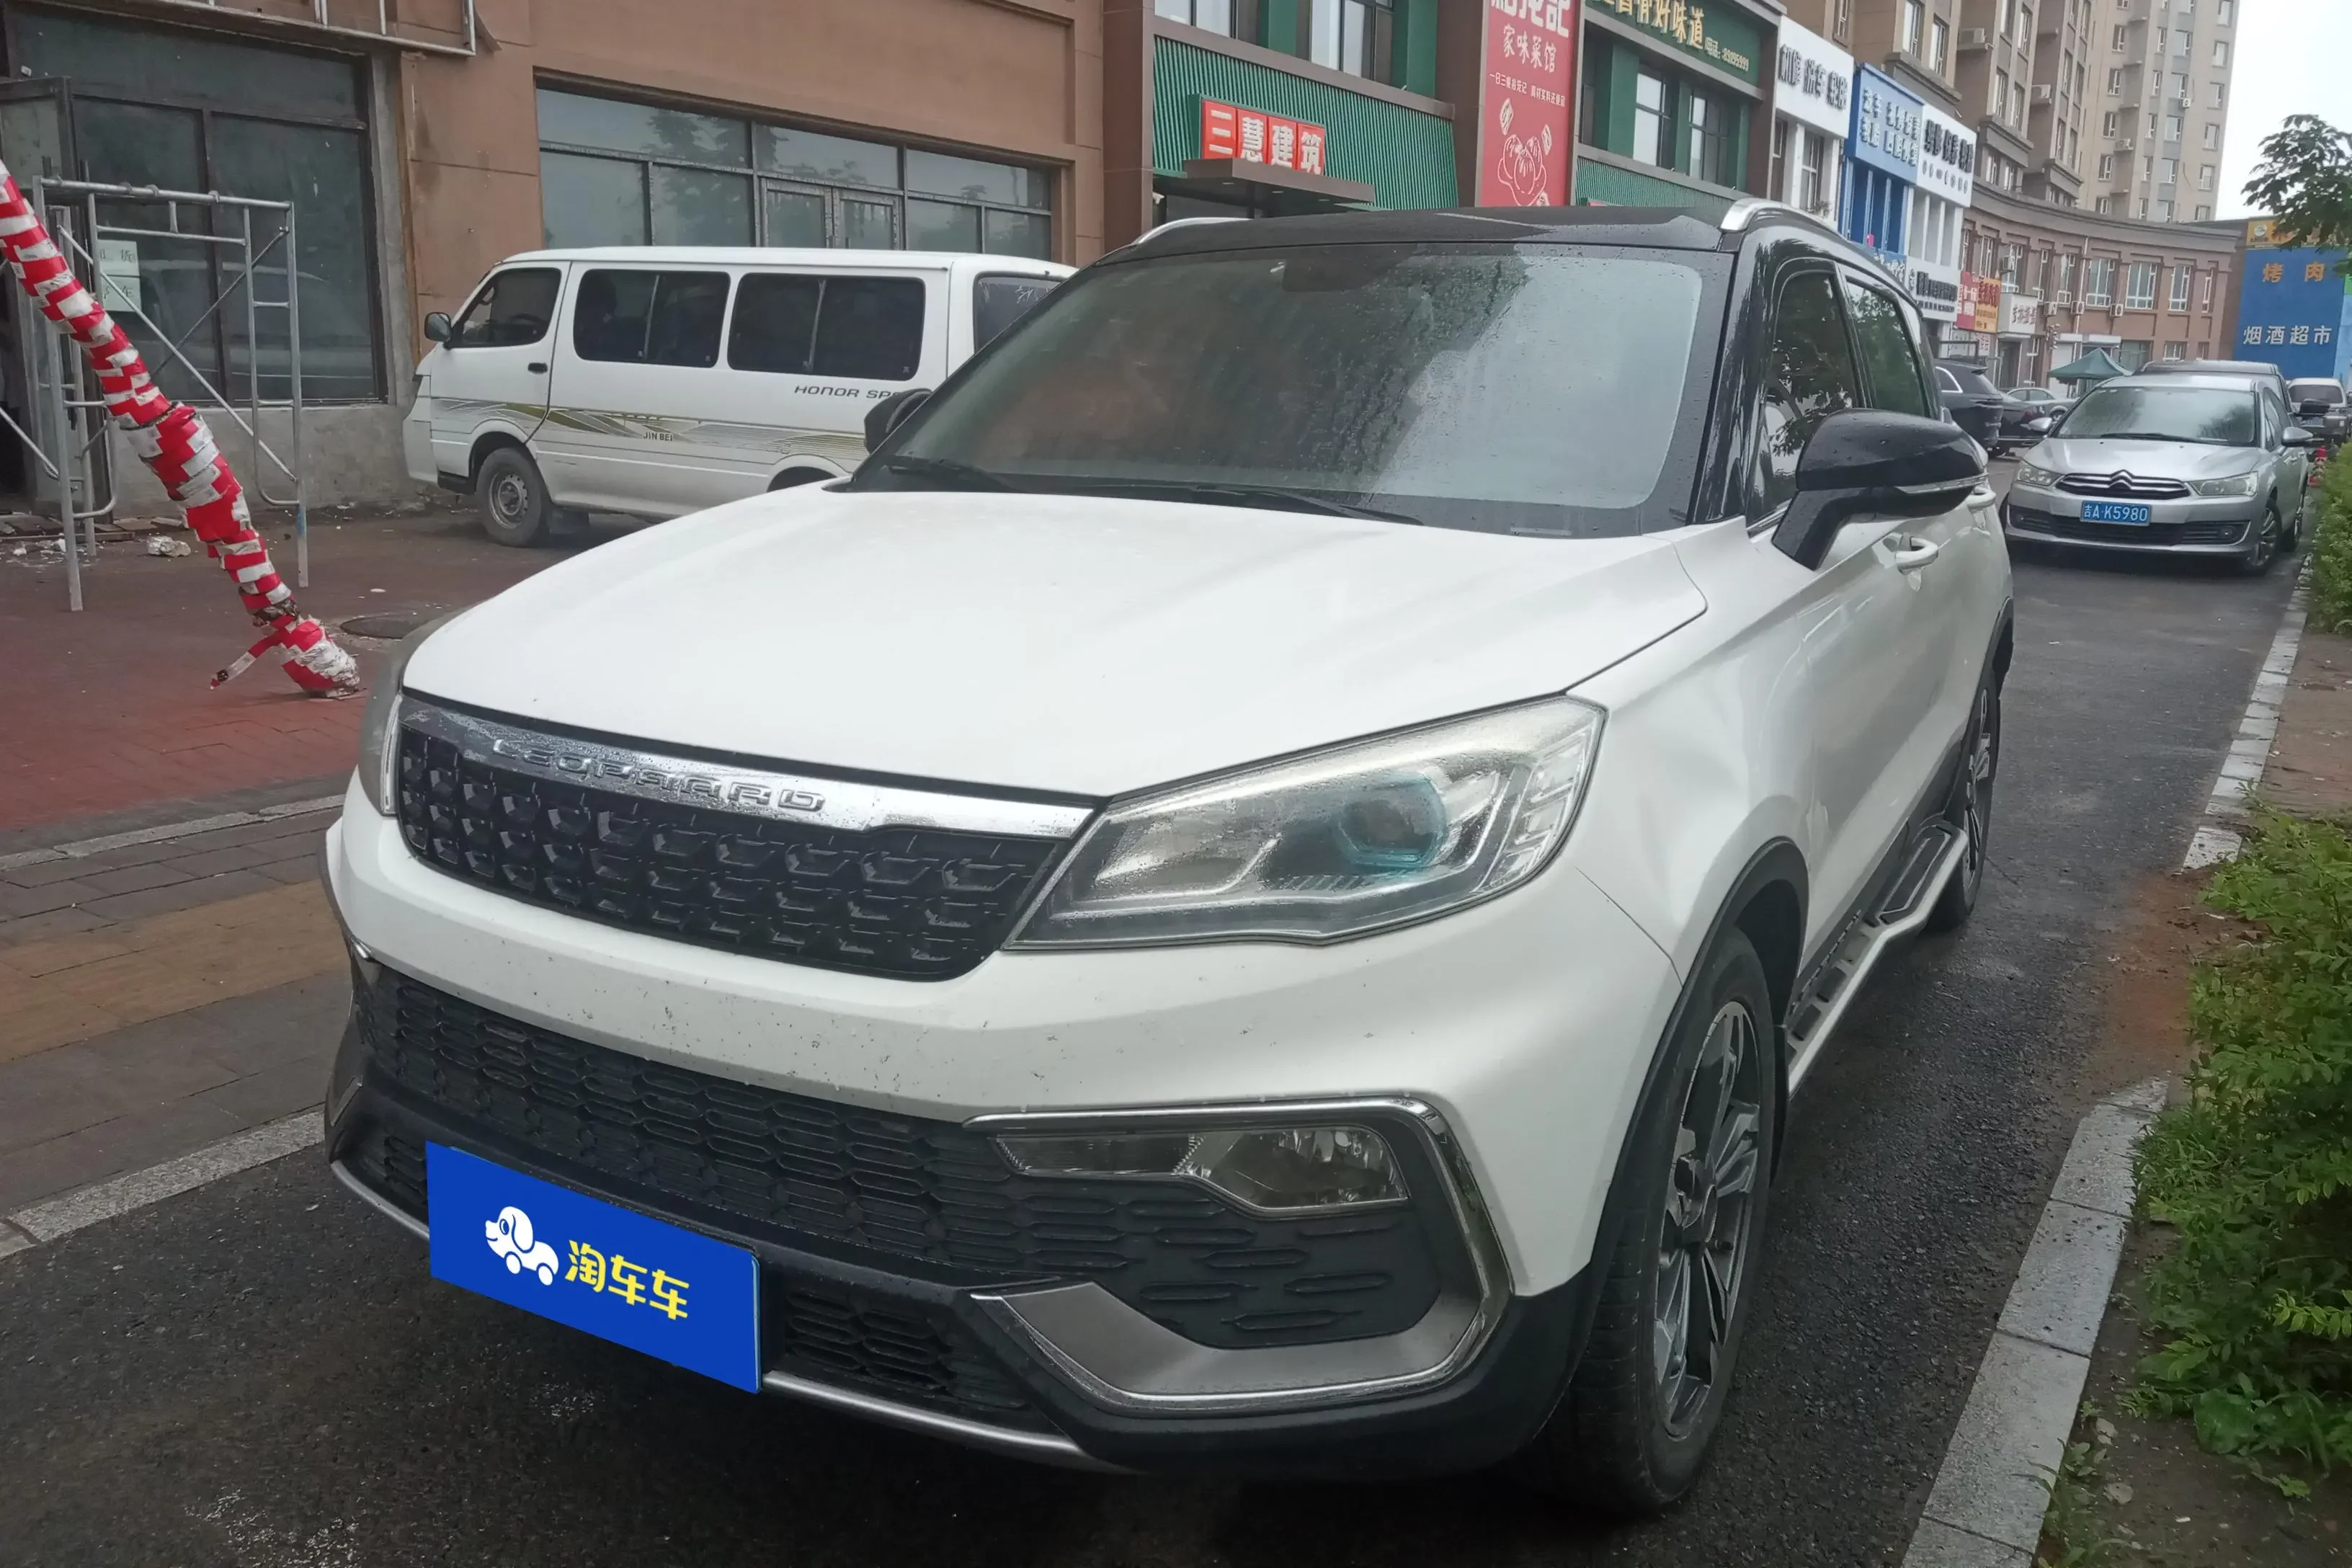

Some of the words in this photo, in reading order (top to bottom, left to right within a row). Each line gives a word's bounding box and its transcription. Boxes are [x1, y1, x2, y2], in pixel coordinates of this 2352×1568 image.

[1209, 109, 1322, 175] 三慧建筑
[2242, 325, 2333, 346] 烟酒超市
[794, 385, 860, 398] HONOR
[865, 390, 899, 399] SP
